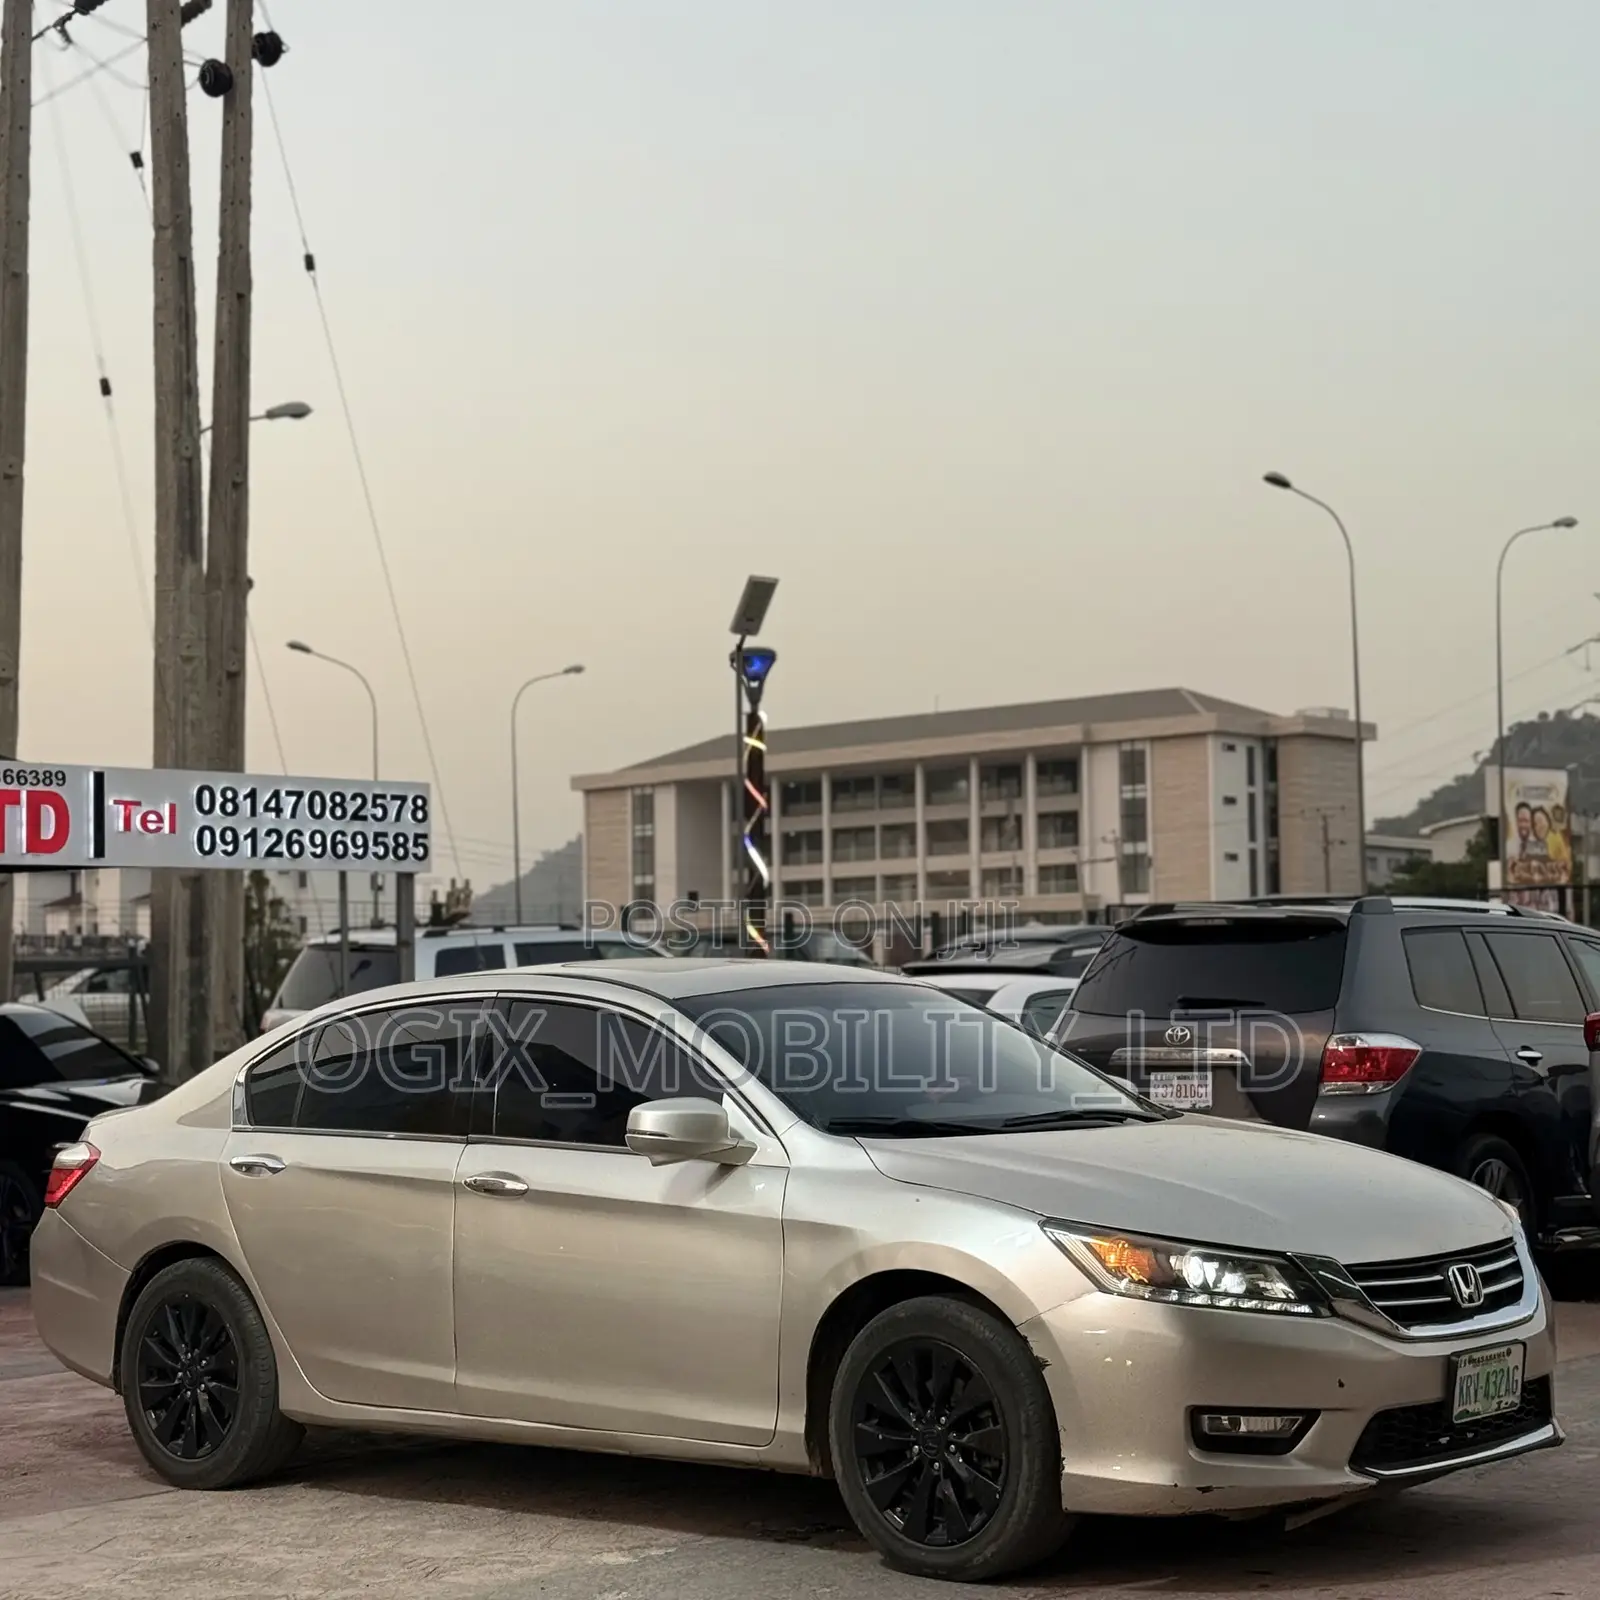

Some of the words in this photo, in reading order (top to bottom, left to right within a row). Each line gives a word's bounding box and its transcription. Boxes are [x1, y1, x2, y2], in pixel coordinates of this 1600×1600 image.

[0, 768, 67, 787] 66389
[110, 799, 177, 834] Tel
[195, 784, 429, 824] 08147082578
[195, 824, 430, 862] 09126969585
[1458, 1365, 1519, 1408] KRV-432AG
